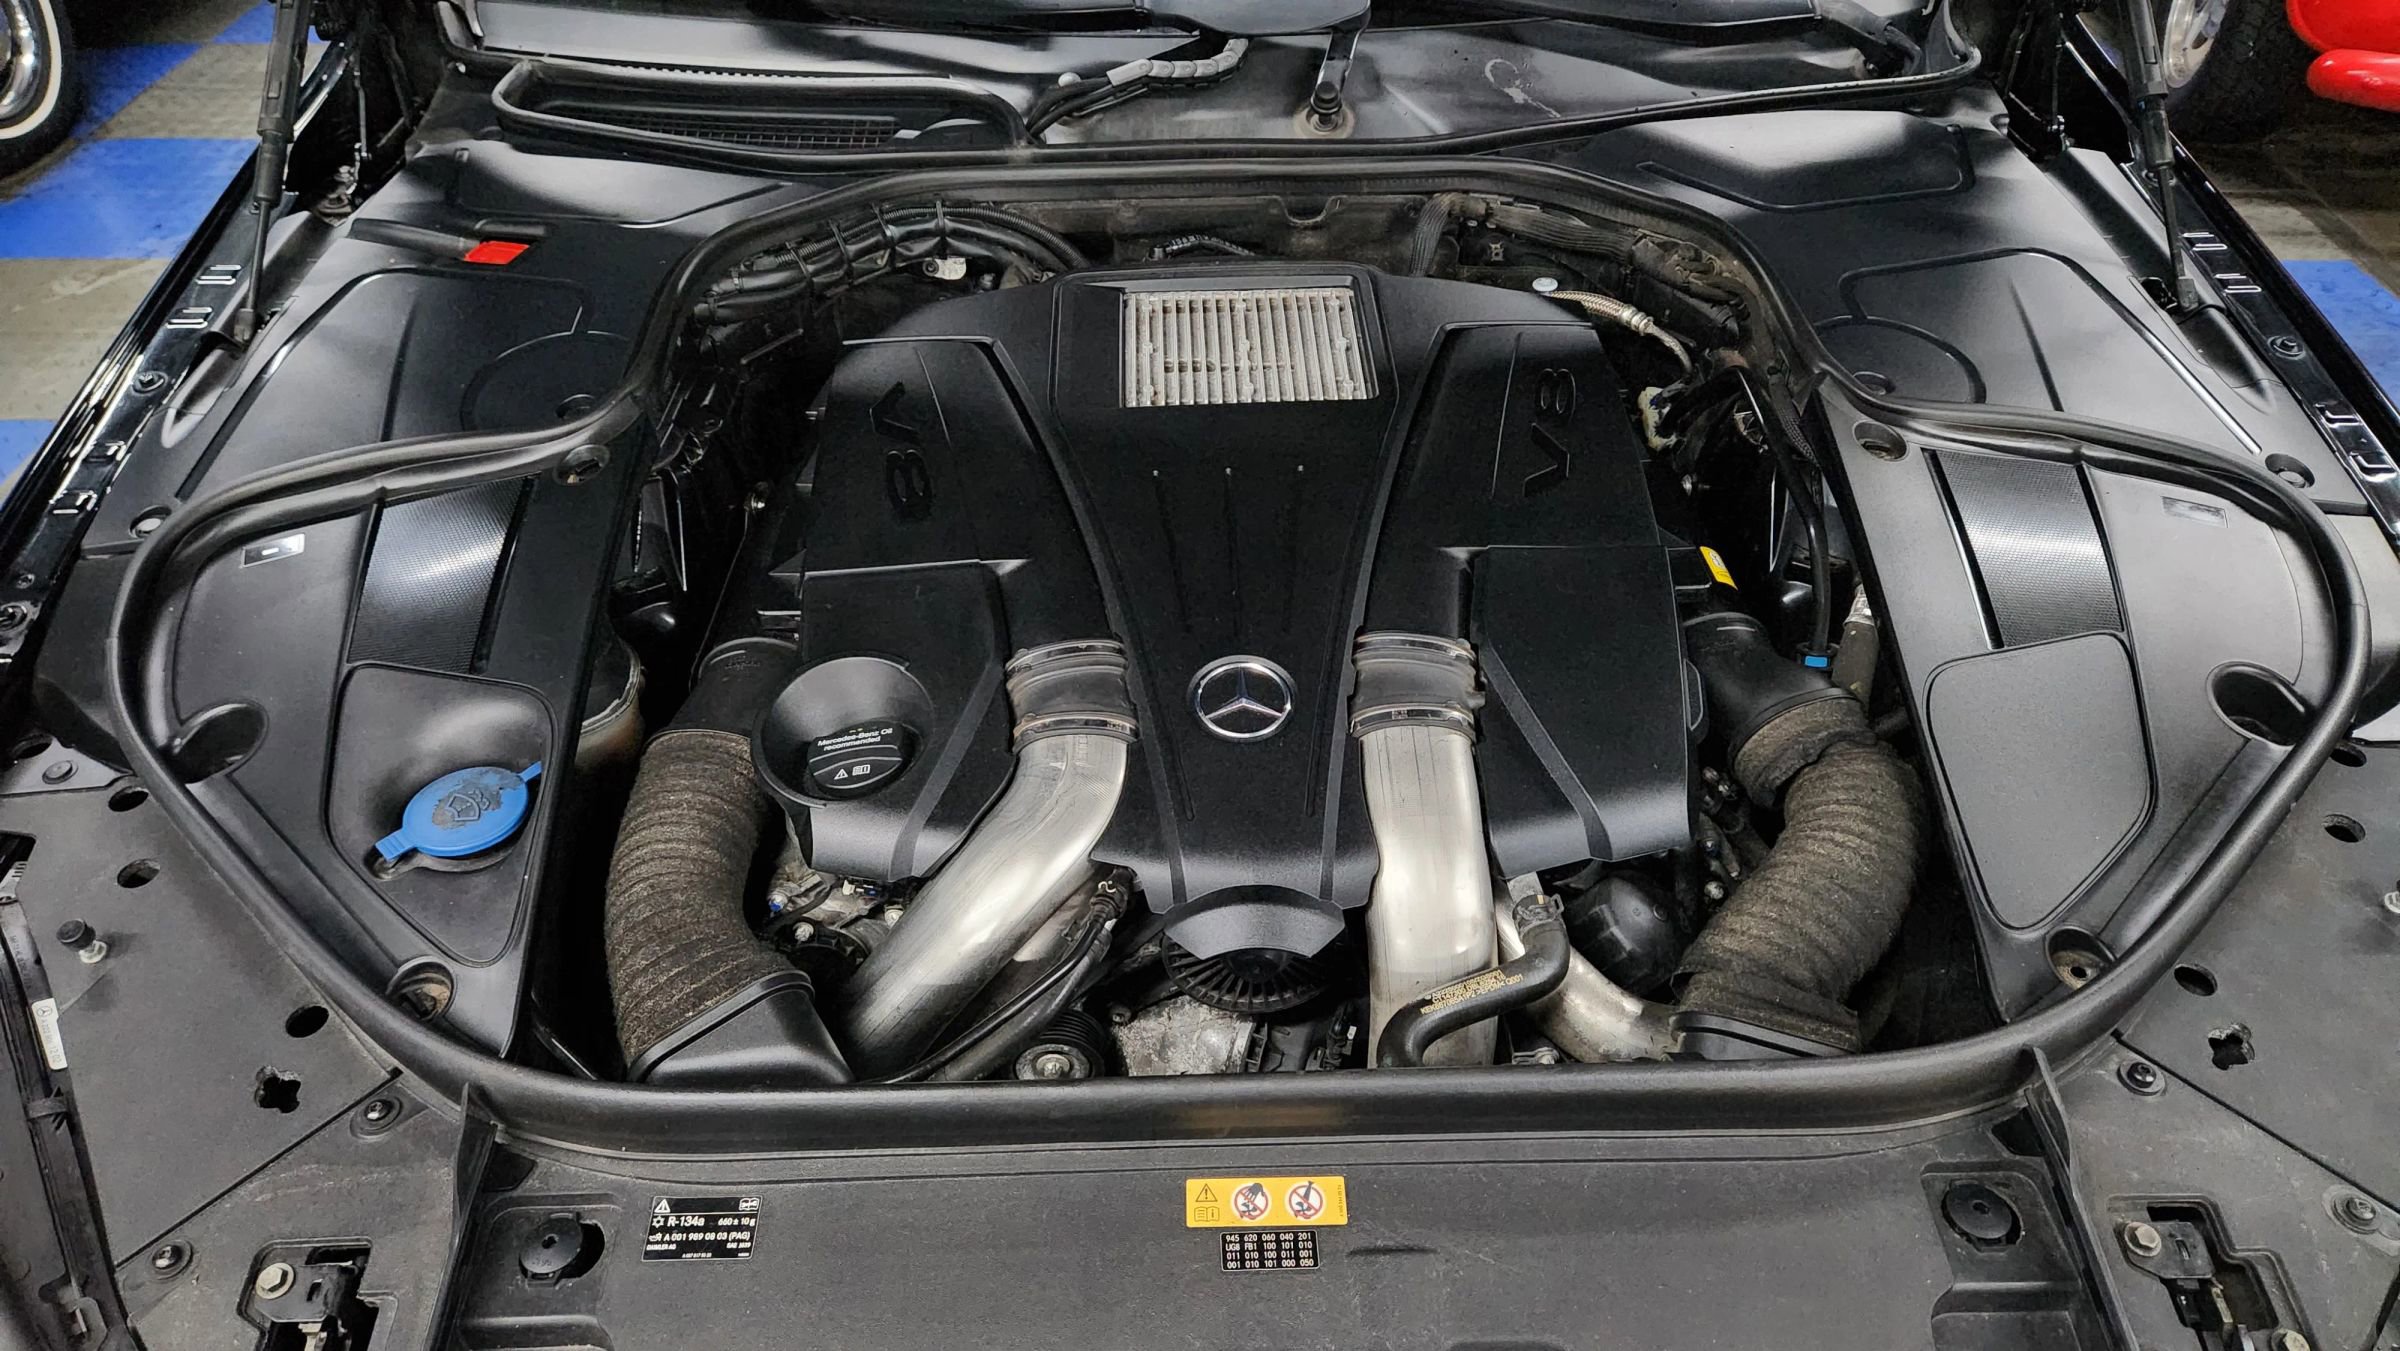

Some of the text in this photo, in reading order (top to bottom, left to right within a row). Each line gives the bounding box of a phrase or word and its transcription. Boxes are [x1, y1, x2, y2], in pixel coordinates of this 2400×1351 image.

[1521, 367, 1577, 498] V8
[869, 379, 933, 521] V8
[817, 727, 893, 747] Mercedes-Benz Oil
[823, 735, 881, 751] recommended
[667, 1215, 705, 1227] R-134a
[718, 1217, 733, 1226] 660
[741, 1217, 750, 1226] 10
[663, 1231, 751, 1242] A 001 989 08 03 (PAG)
[1226, 1234, 1240, 1242] 945
[1261, 1233, 1276, 1241] 060
[1298, 1232, 1311, 1240] 201
[1263, 1242, 1276, 1250] 100
[1298, 1241, 1313, 1249] 010
[1226, 1250, 1312, 1260] 011 010 100 011 001
[1227, 1261, 1240, 1269] 001
[1245, 1260, 1259, 1268] 010
[1264, 1260, 1277, 1268] 101
[1281, 1259, 1296, 1267] 000
